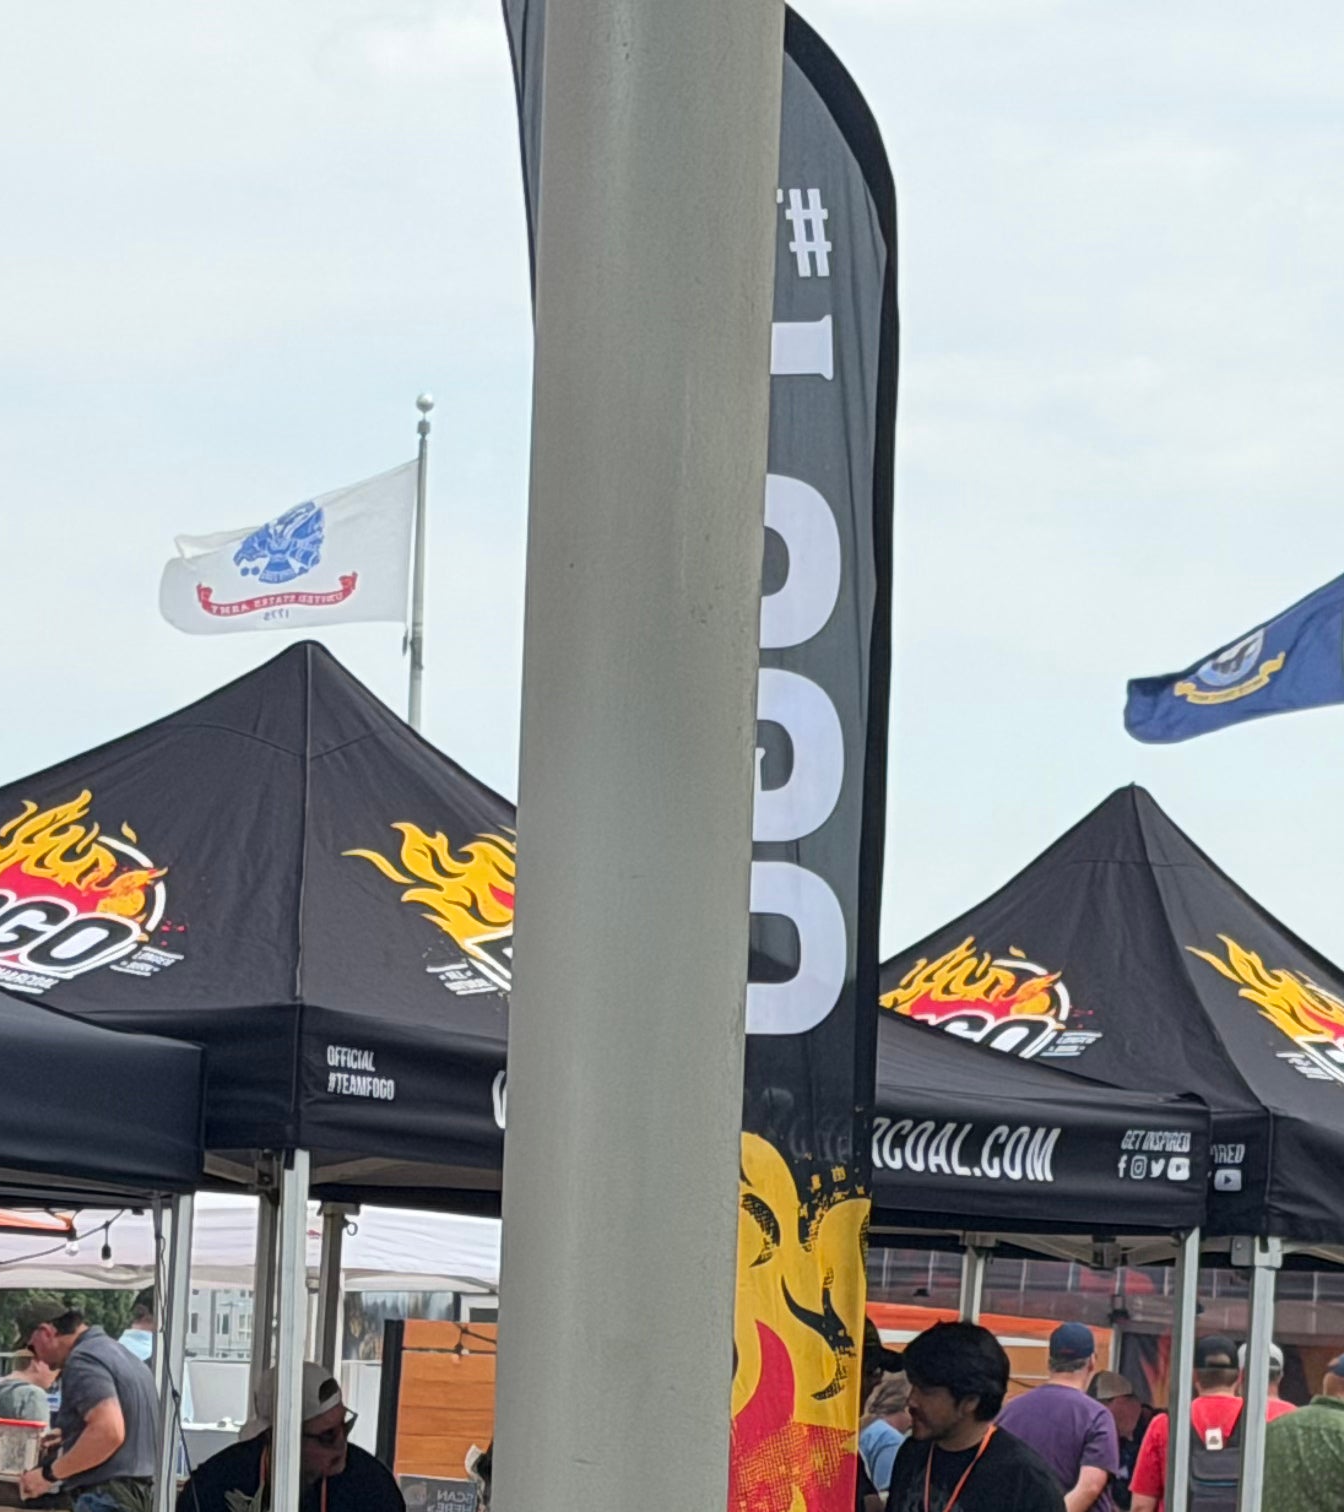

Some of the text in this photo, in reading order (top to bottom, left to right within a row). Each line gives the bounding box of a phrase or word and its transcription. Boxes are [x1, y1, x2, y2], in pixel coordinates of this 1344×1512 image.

[326, 1044, 376, 1072] OFFICIAL
[327, 1071, 395, 1101] #TEAMFOGO
[1121, 1129, 1143, 1151] GET
